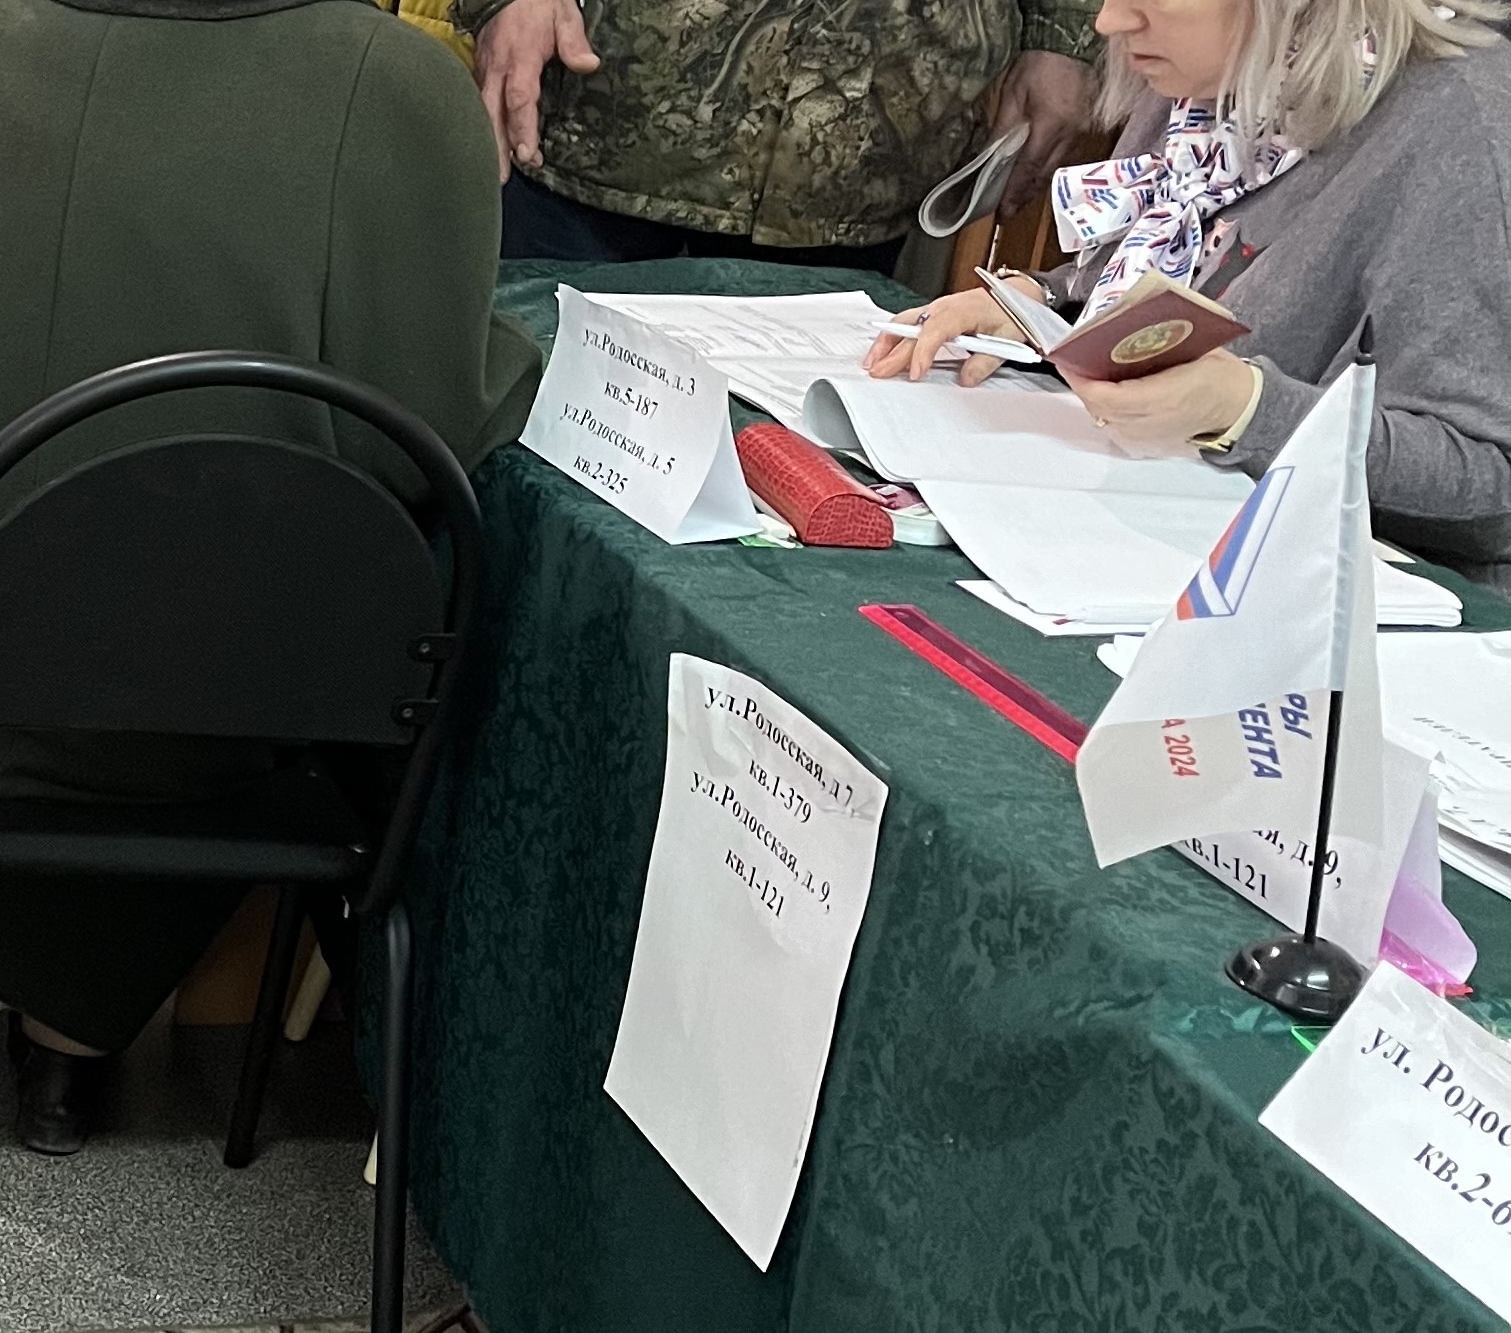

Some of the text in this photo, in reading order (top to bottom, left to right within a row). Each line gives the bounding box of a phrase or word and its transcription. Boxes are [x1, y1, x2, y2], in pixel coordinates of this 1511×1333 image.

[582, 328, 696, 397] ул.Родосская, д. 3
[604, 380, 659, 419] кв.5-187
[559, 402, 676, 476] ул.Родосская, д. 5
[573, 455, 629, 495] кв.2-325
[704, 687, 826, 791] ул.Родосская,
[1164, 734, 1200, 777] 2024
[748, 759, 812, 824] кв.1-379
[690, 770, 800, 881] ул.Родосская,
[801, 870, 815, 894] д.
[1290, 839, 1314, 868] д.
[725, 848, 785, 918] кв.1-121
[1360, 1027, 1411, 1075] ул.
[1413, 1141, 1511, 1236] кв.2-6
